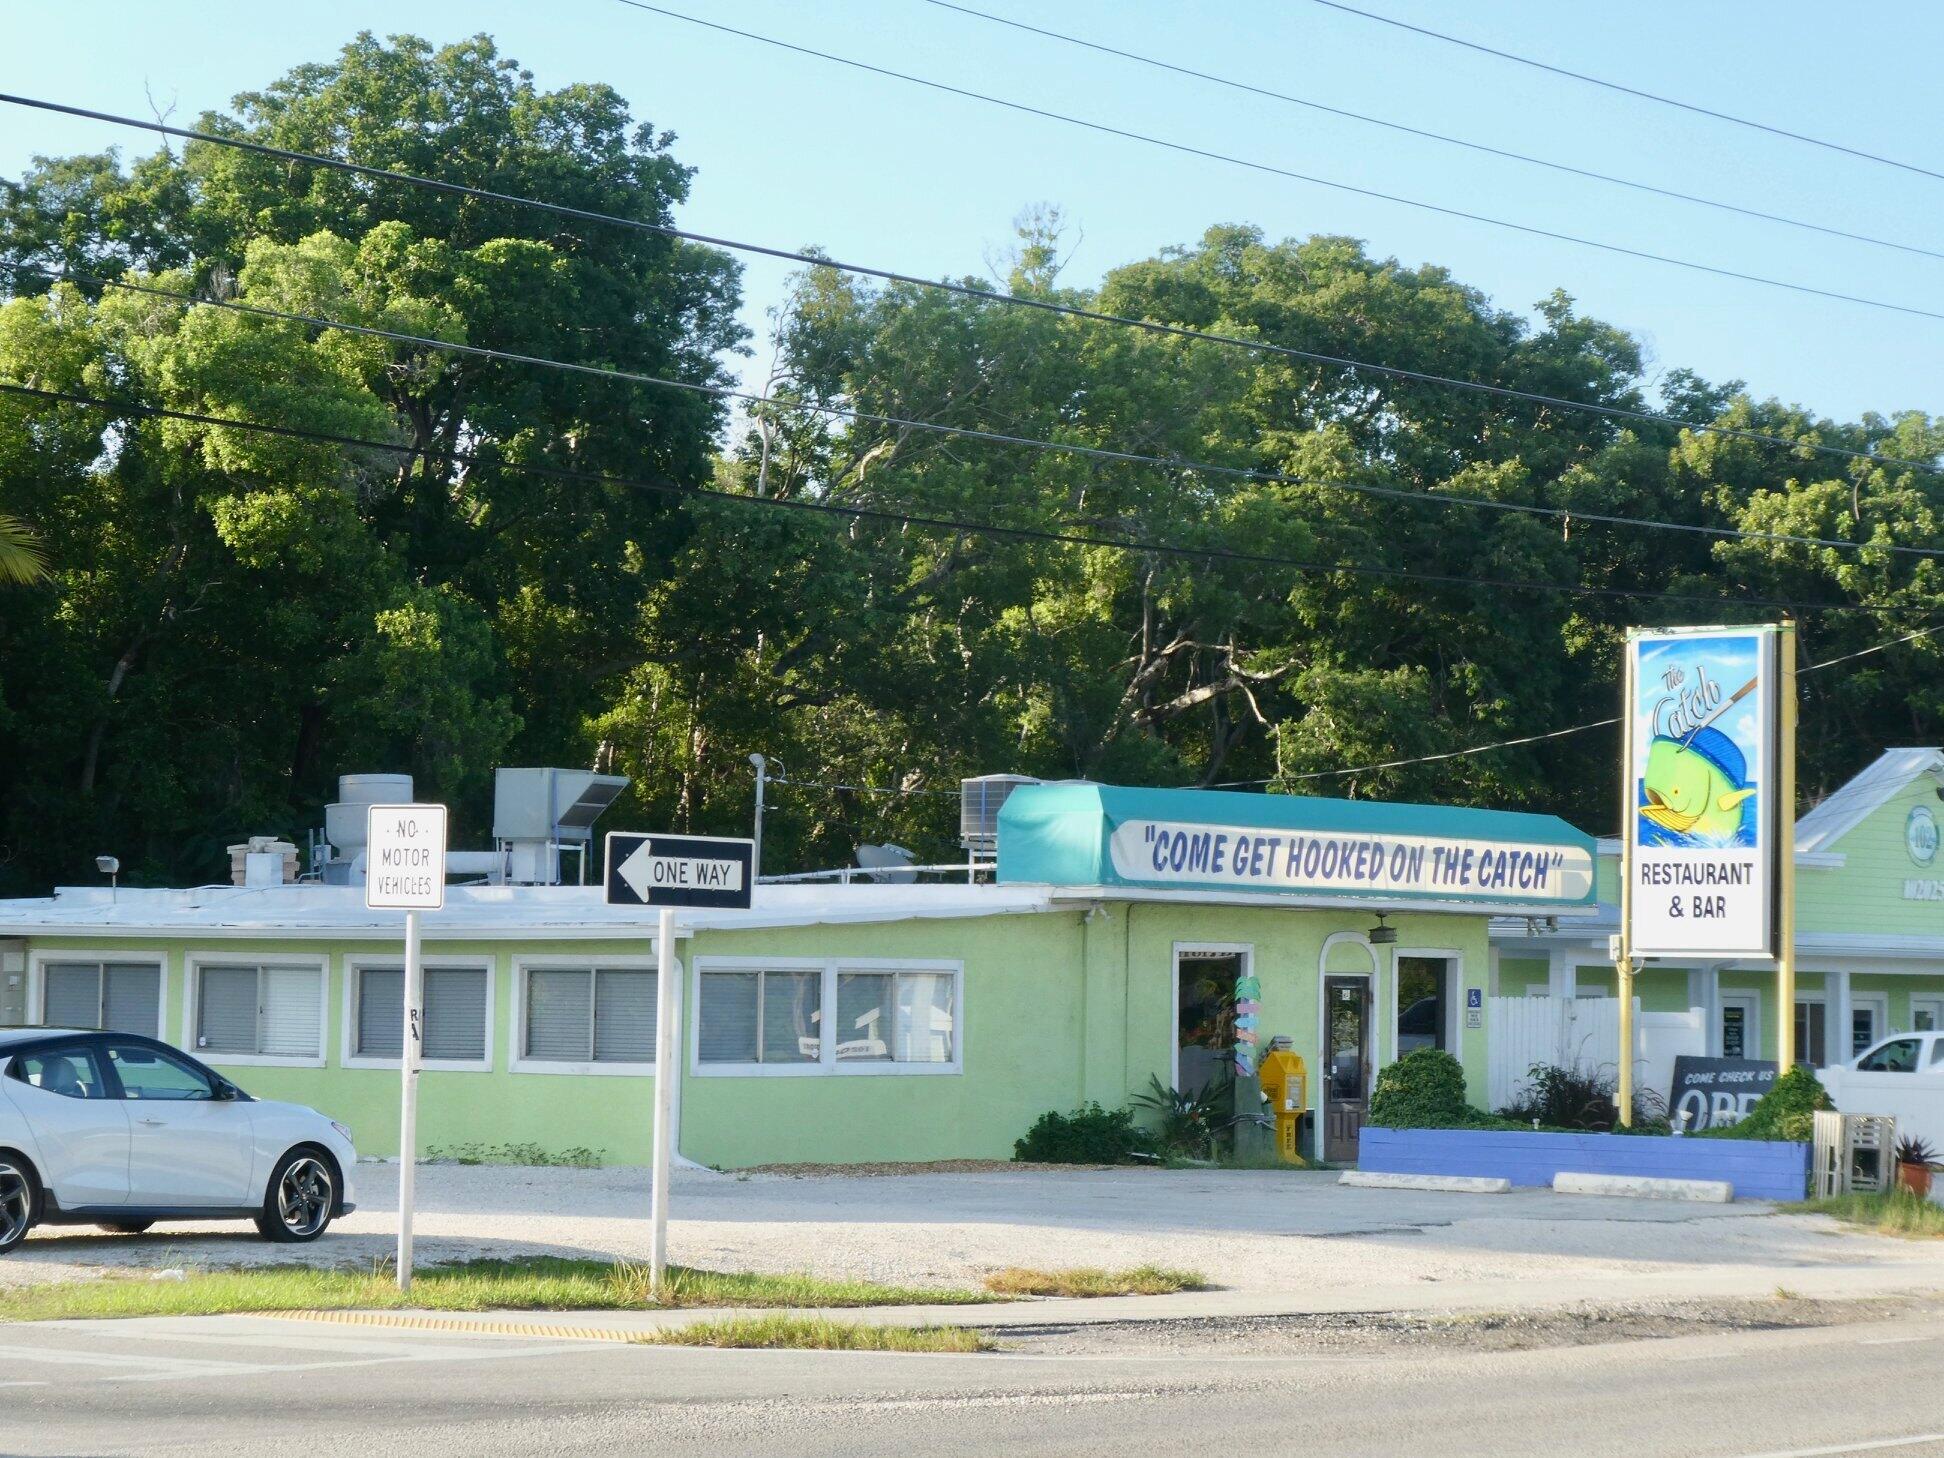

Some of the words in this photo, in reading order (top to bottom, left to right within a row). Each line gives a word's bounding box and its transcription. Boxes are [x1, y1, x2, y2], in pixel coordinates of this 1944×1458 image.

[1653, 665, 1720, 739] Catch
[398, 820, 416, 838] NO
[382, 848, 430, 867] MOTOR
[1145, 825, 1228, 874] "COME
[1233, 836, 1281, 877] GET
[1286, 837, 1385, 881] HOOKED
[1390, 844, 1424, 884] ON
[1433, 846, 1474, 886] THE
[1478, 849, 1563, 890] CATCH"
[654, 861, 688, 884] ONE
[696, 862, 731, 886] WAY
[1641, 862, 1753, 885] RESTAURANT
[378, 877, 432, 895] VEHICLES
[1669, 895, 1684, 918] &
[1693, 895, 1726, 918] BAR
[1684, 1072, 1716, 1085] COME
[1718, 1071, 1755, 1083] CHECK
[1758, 1070, 1774, 1081] US
[1676, 1089, 1763, 1132] OPE
